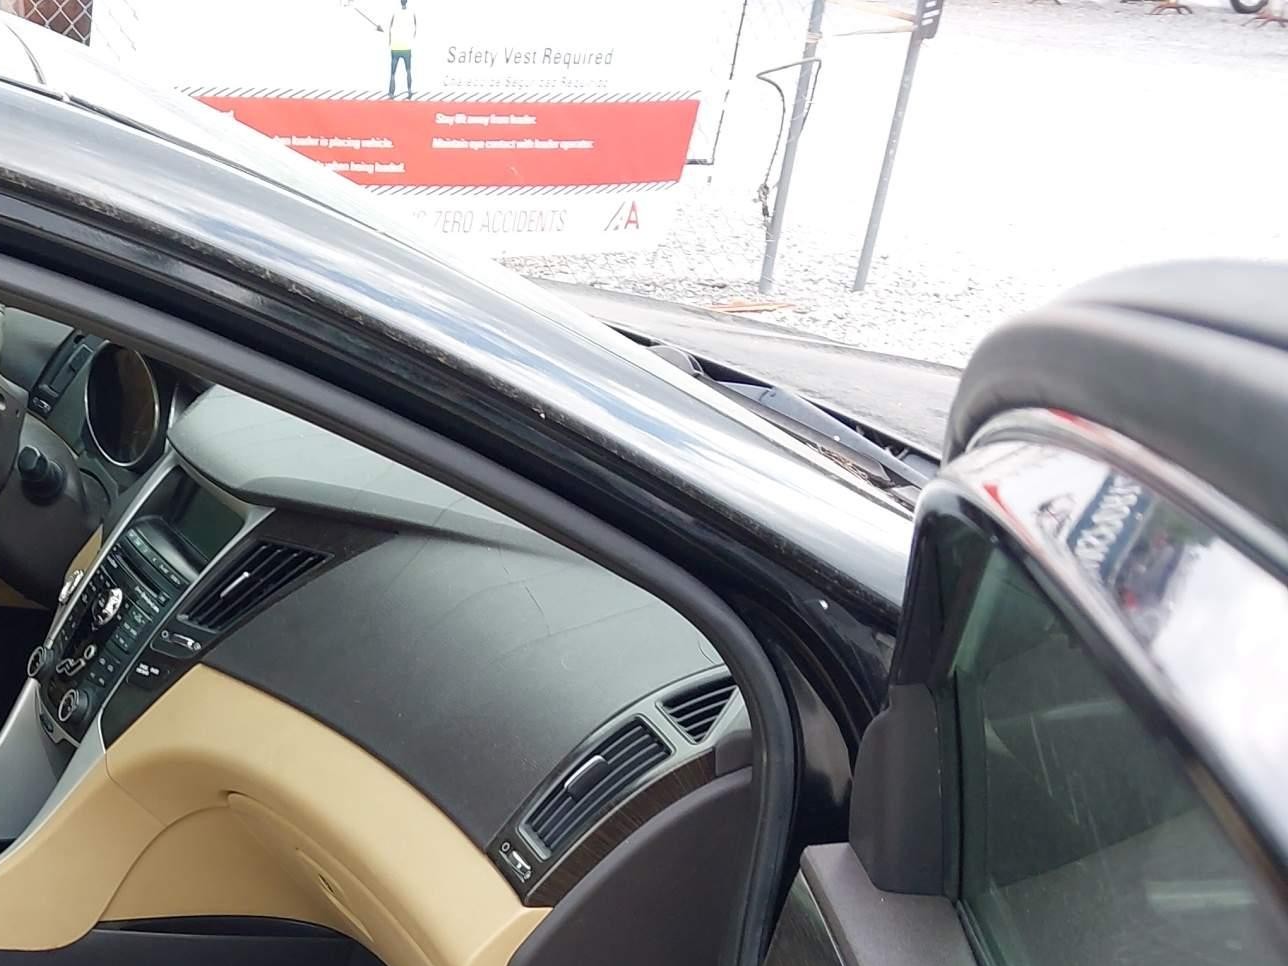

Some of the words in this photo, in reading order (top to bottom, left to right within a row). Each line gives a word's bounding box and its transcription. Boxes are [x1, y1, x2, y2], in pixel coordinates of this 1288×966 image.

[447, 45, 497, 68] Safety
[504, 47, 537, 65] Vest
[542, 47, 614, 70] Required
[433, 209, 475, 234] ZERO
[479, 208, 568, 233] ACCIDENTS
